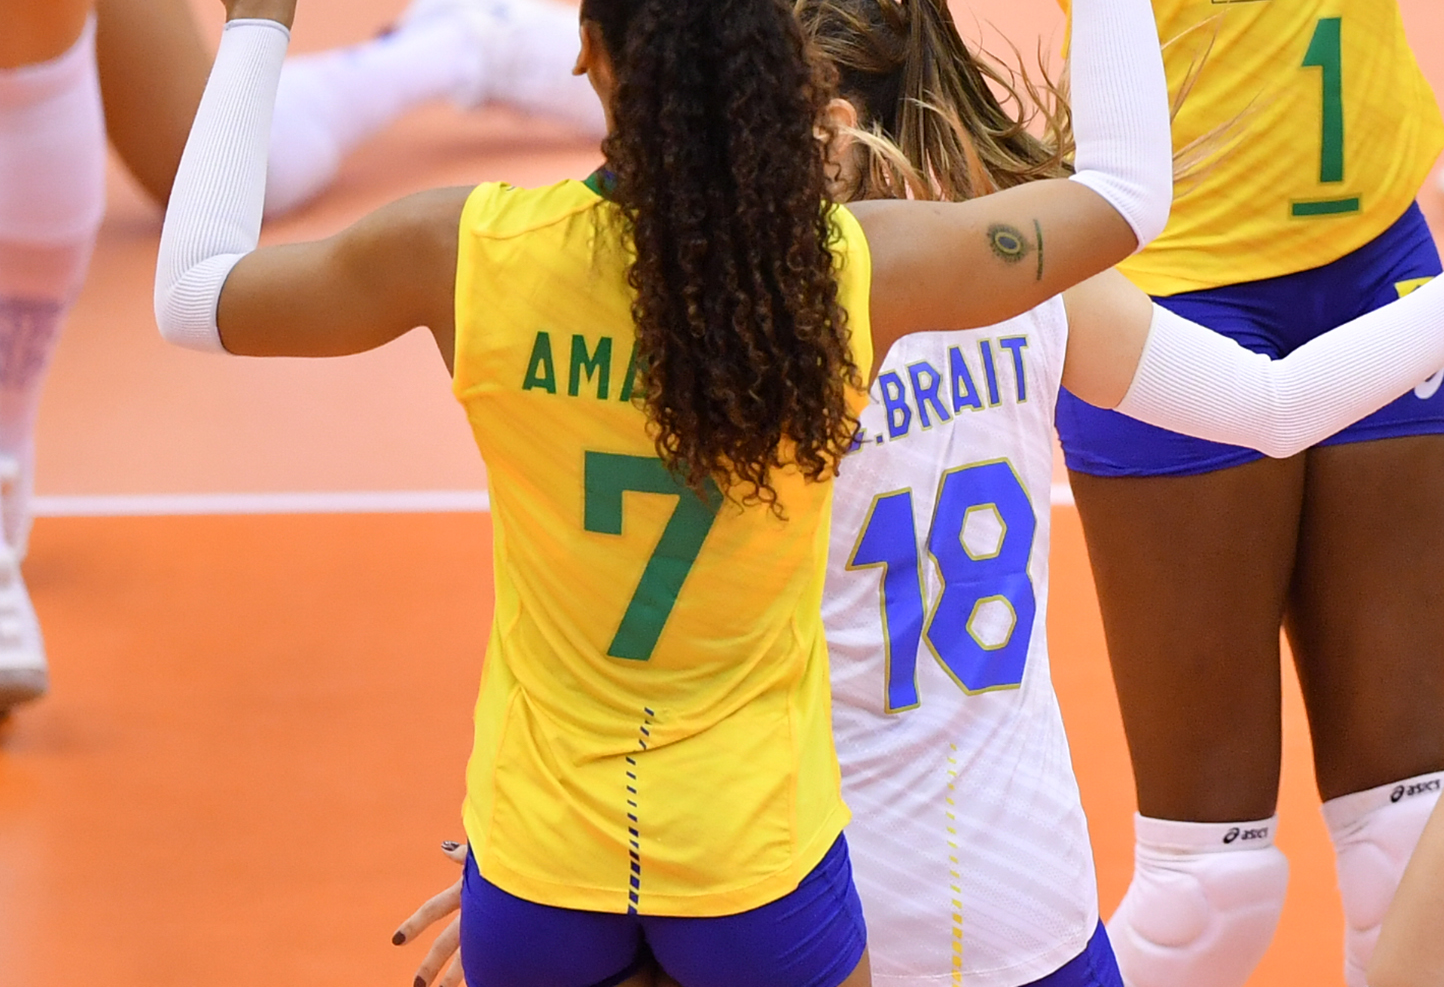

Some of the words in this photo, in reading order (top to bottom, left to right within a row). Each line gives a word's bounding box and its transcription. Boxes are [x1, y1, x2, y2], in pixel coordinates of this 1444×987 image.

[1301, 17, 1344, 182] 1
[850, 334, 1029, 453] .BRAIT
[584, 450, 725, 662] 7
[845, 456, 1037, 715] 18
